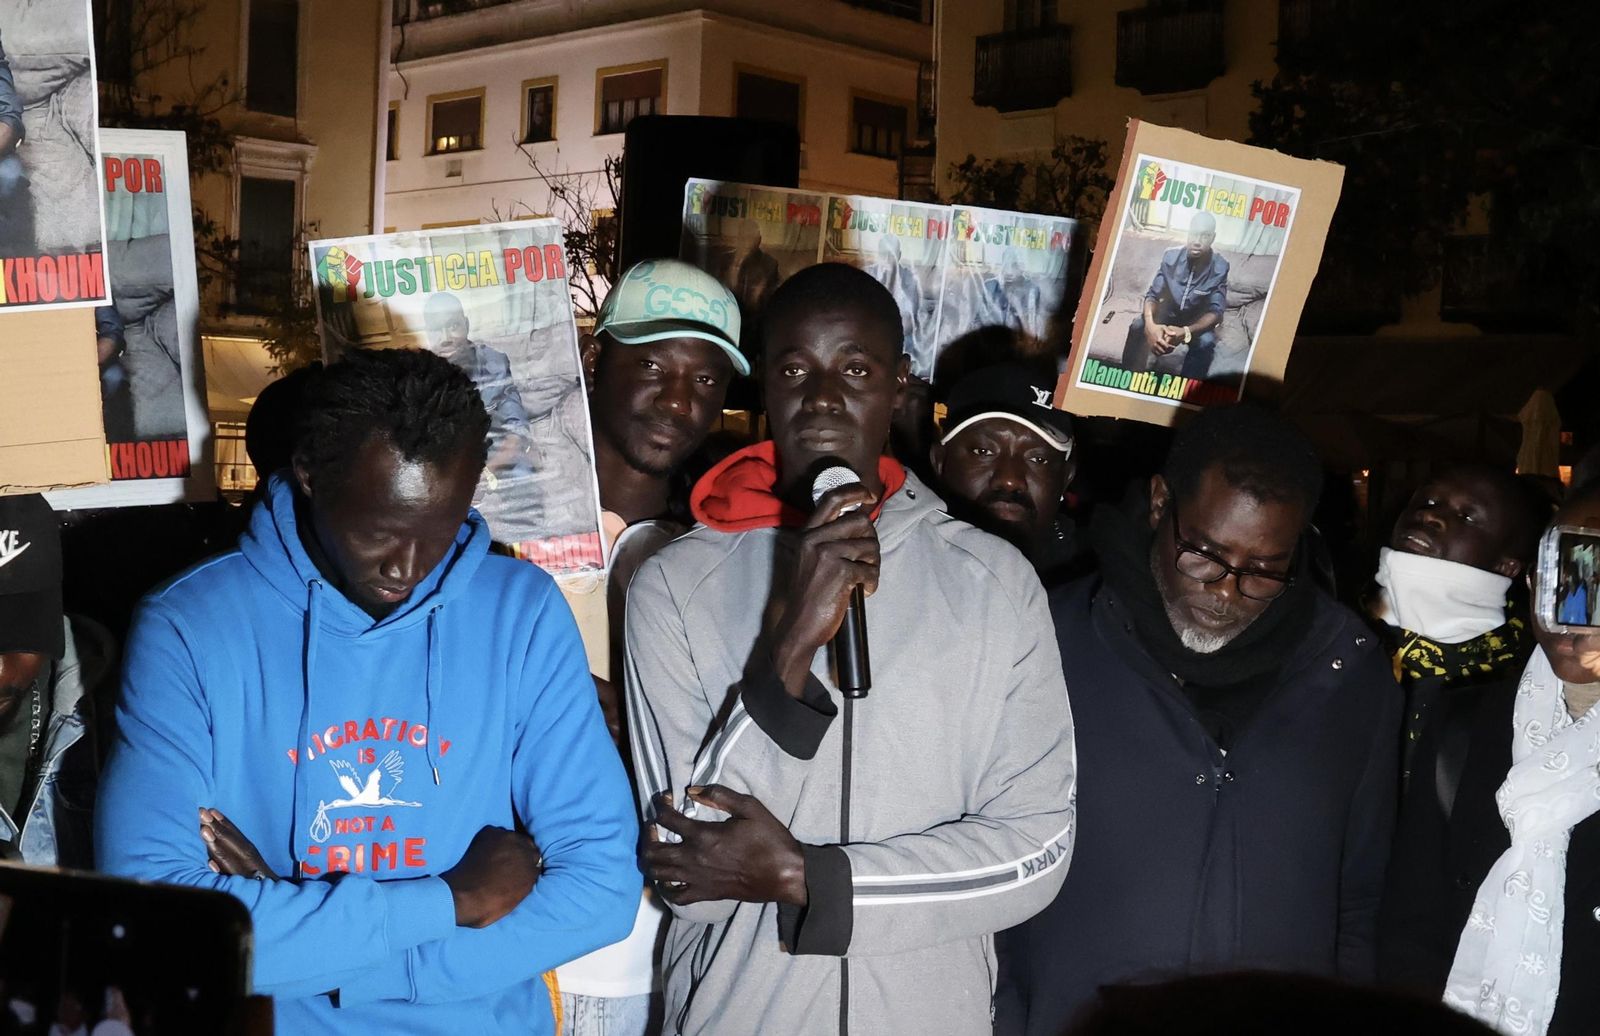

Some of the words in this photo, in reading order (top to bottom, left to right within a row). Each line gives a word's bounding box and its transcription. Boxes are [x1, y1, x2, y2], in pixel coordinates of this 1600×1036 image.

[105, 157, 163, 193] POR
[787, 203, 821, 225] POR
[1160, 178, 1248, 219] JUSTICIA
[1248, 196, 1290, 228] POR
[850, 209, 923, 239] JUSTICIA
[927, 217, 949, 240] PO
[363, 249, 499, 299] JUSTICIA
[503, 243, 564, 285] POR
[1081, 359, 1158, 395] Mamouth
[358, 748, 376, 764] IS
[335, 816, 376, 834] NOT
[381, 815, 395, 832] A
[301, 838, 427, 874] CRIME
[1021, 841, 1066, 878] YORK
